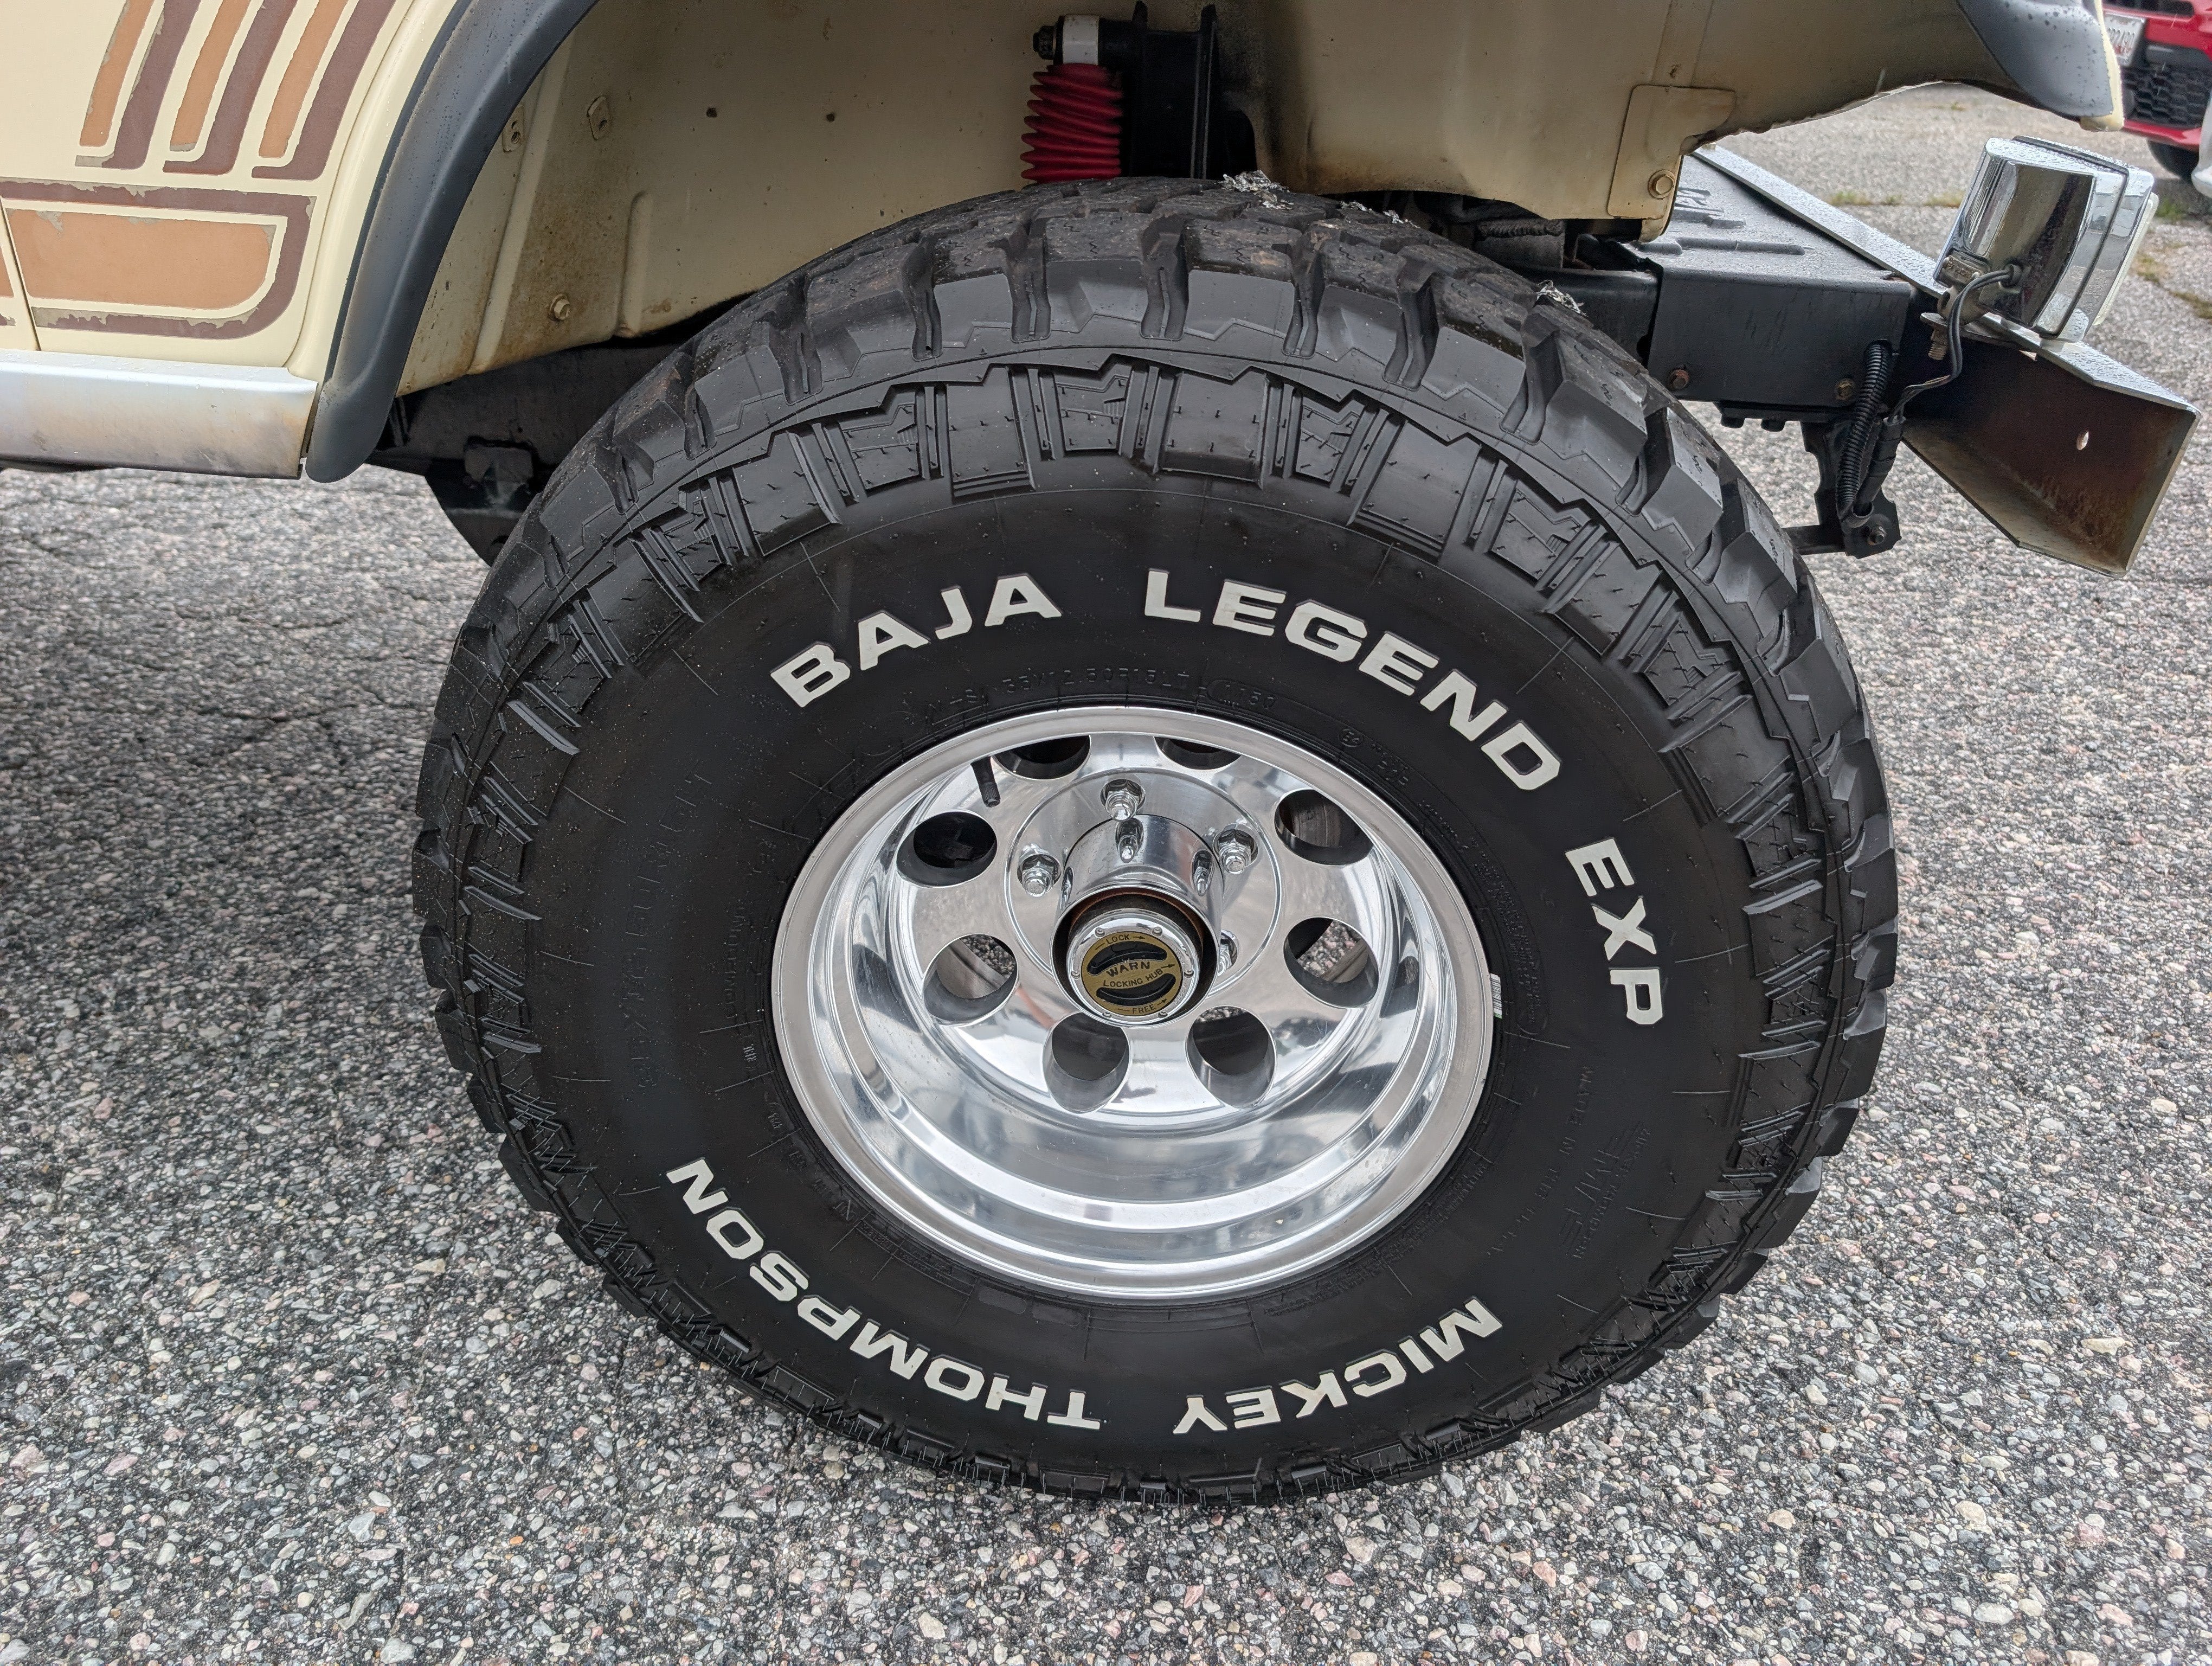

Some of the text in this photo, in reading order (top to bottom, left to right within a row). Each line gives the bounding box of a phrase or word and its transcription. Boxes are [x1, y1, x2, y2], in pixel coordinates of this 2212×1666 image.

[770, 574, 1062, 707] BAJA
[1144, 569, 1561, 791] LEGEND
[1565, 838, 1663, 1024] EXP
[1105, 934, 1130, 946] LOCK
[1103, 968, 1163, 988] LOCKING HUB
[1106, 962, 1150, 977] WARN
[1132, 1003, 1156, 1014] FREE
[666, 1157, 1101, 1430] THOMPSON
[1173, 1297, 1502, 1434] MICKEY
